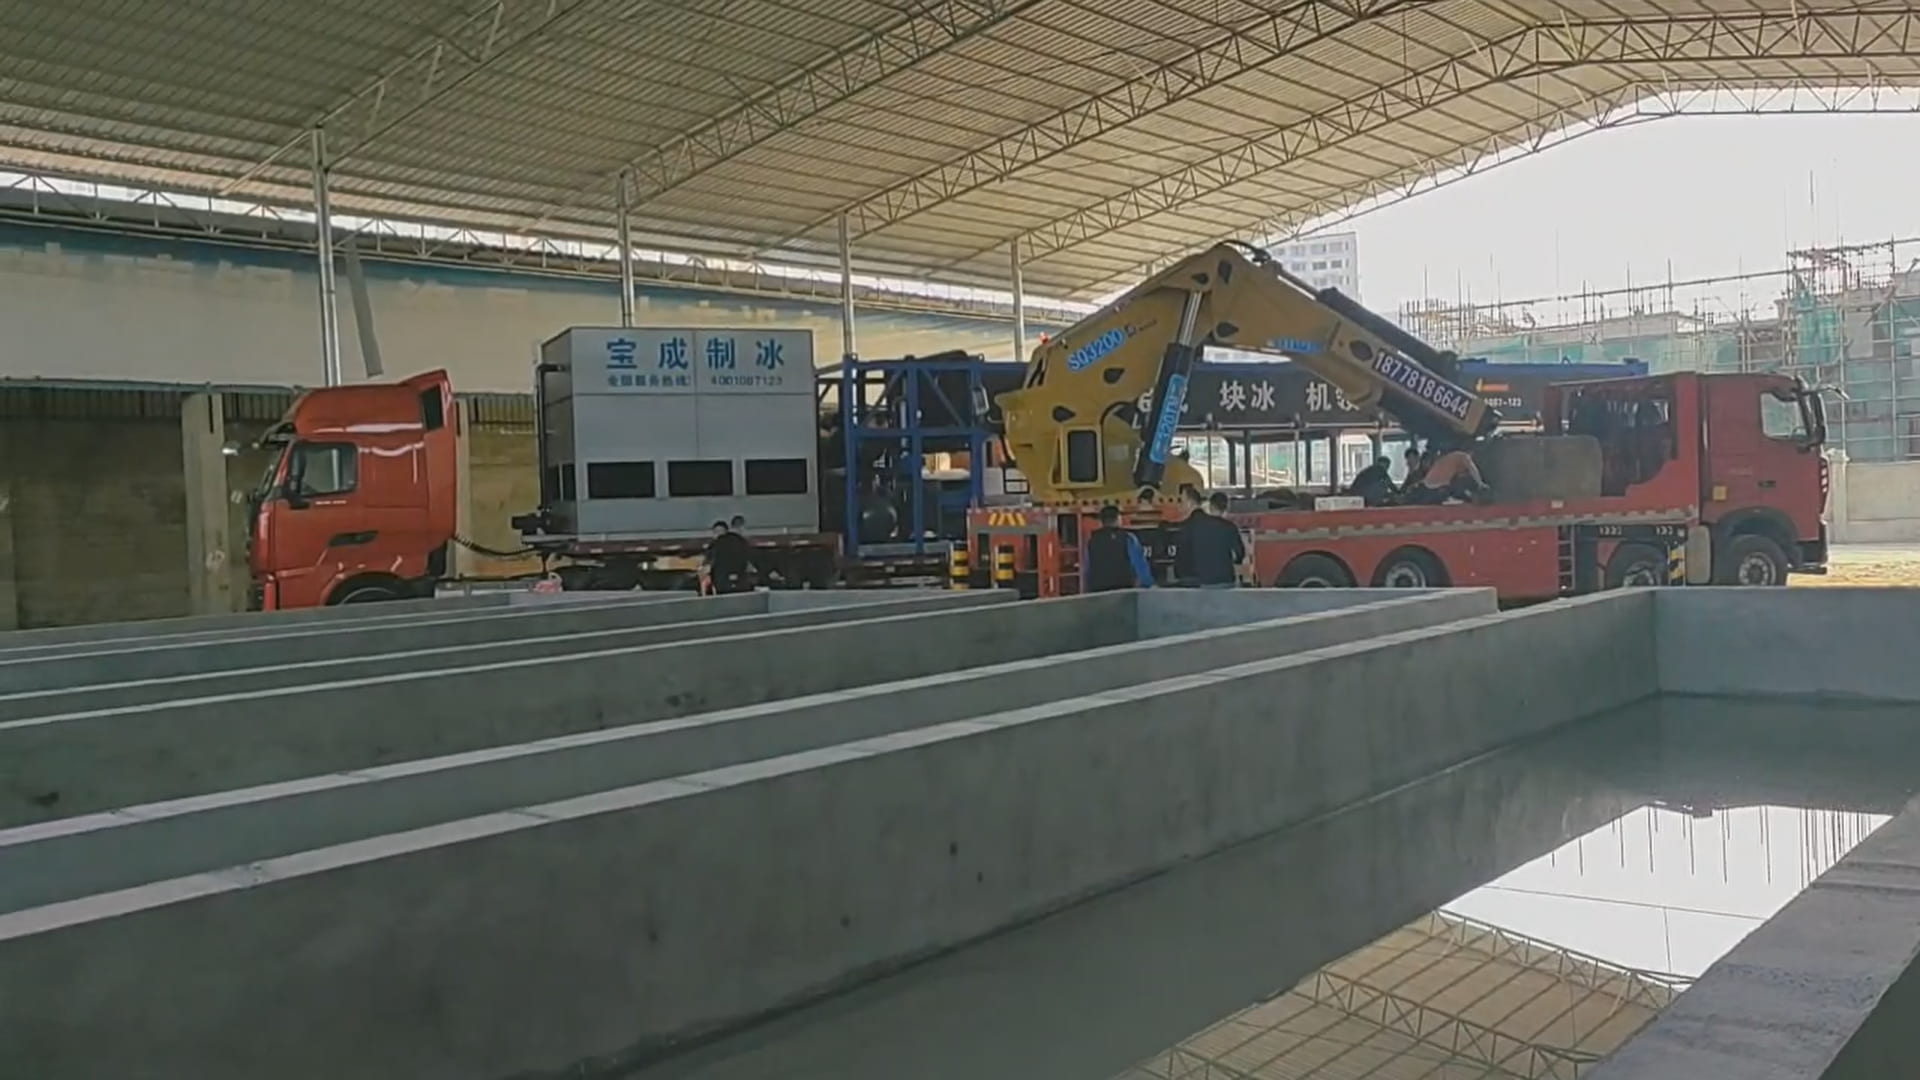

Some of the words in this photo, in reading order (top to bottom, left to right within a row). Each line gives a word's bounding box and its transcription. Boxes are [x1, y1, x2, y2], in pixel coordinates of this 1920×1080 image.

[606, 337, 785, 370] 宝成制冰
[1219, 380, 1276, 412] 块冰
[1374, 351, 1470, 418] 18778186644
